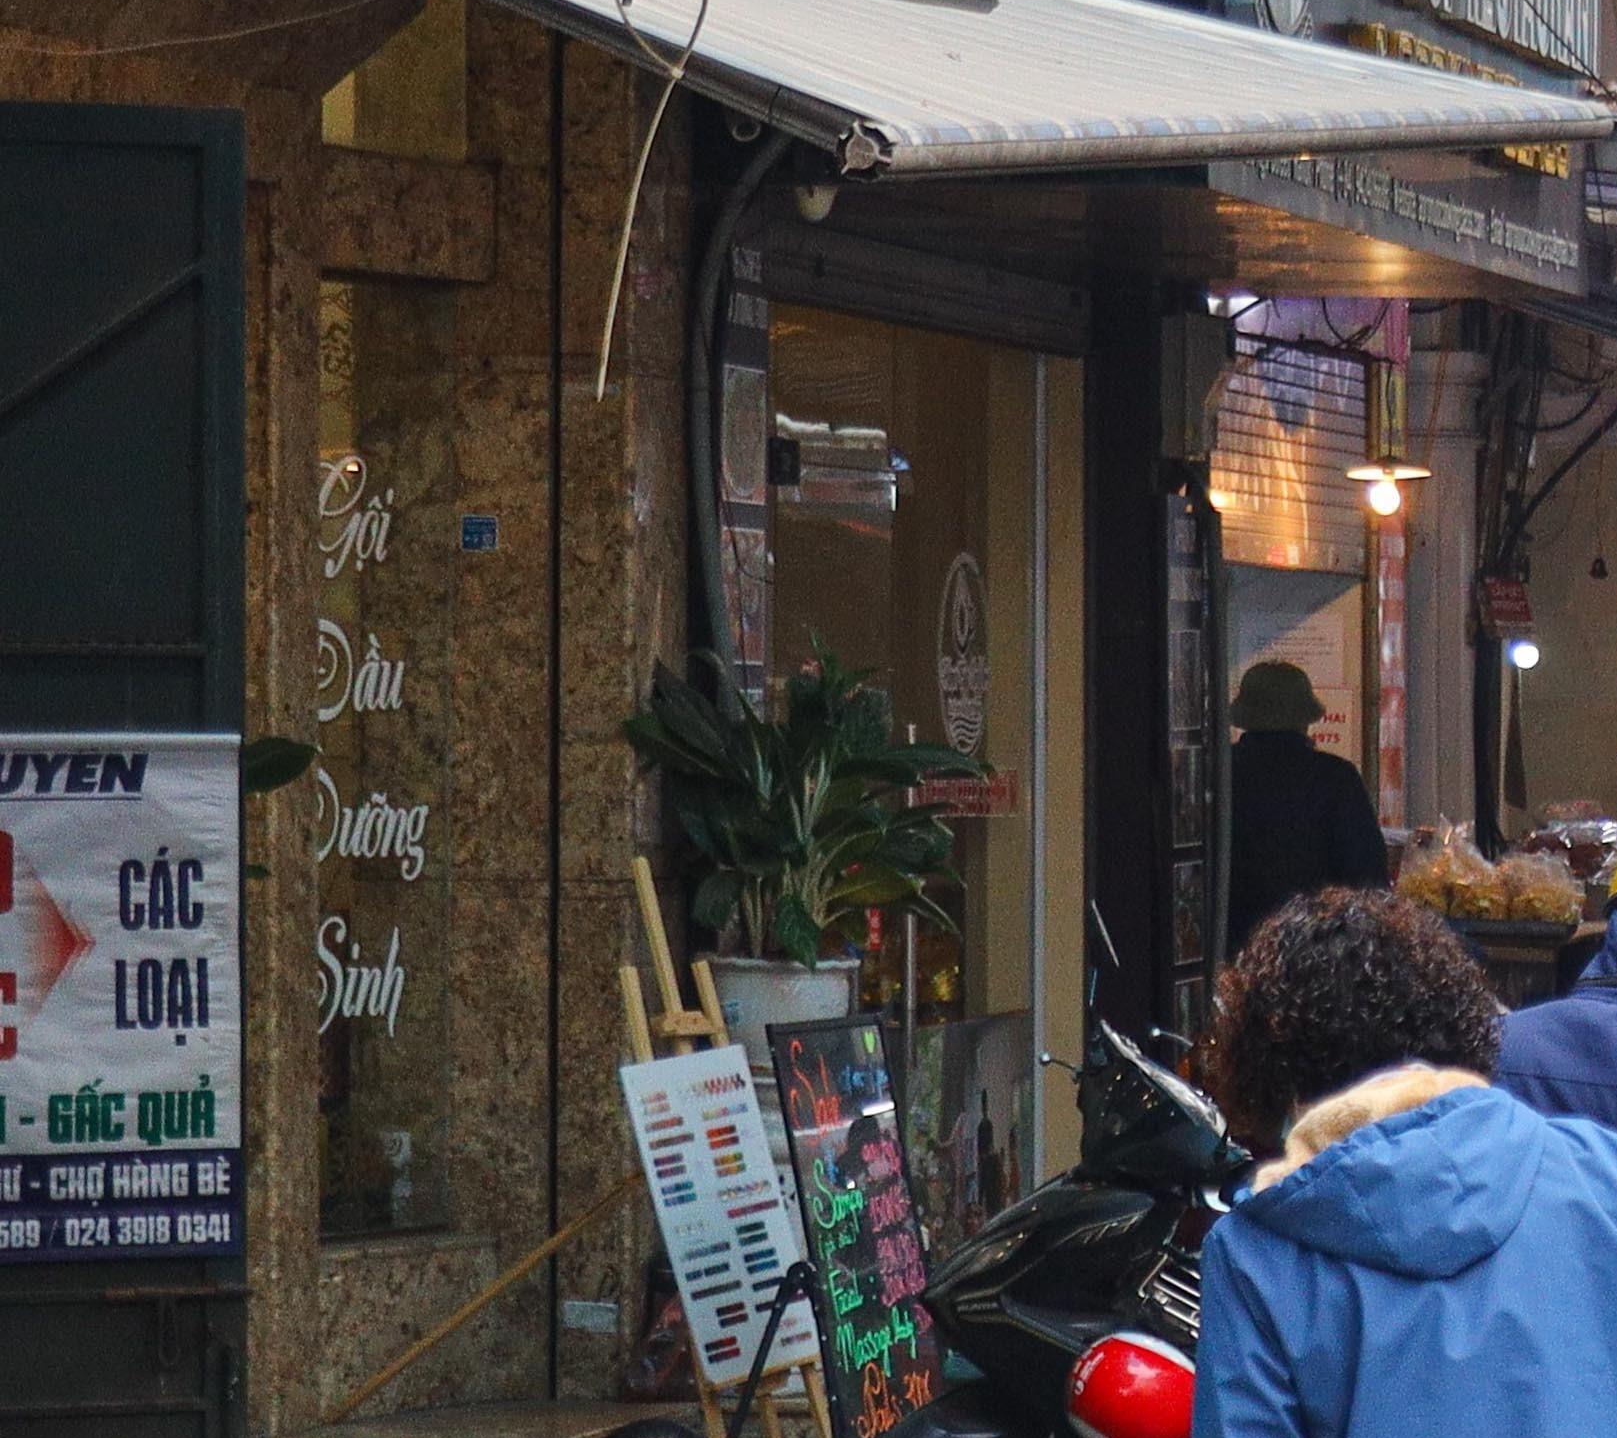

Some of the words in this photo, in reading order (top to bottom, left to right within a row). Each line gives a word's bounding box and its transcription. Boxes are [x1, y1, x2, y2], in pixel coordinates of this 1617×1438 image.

[119, 846, 205, 931] CÁC
[115, 958, 209, 1046] LOẠI
[317, 915, 403, 1037] Sinh
[48, 1078, 125, 1144] GẤC
[137, 1073, 215, 1147] QUẢ
[50, 1161, 105, 1207] CHỢ
[112, 1158, 189, 1200] HÀNG
[197, 1155, 231, 1196] BÈ
[65, 1216, 110, 1246] 024
[117, 1215, 171, 1245] 3918
[177, 1213, 230, 1243] 0341
